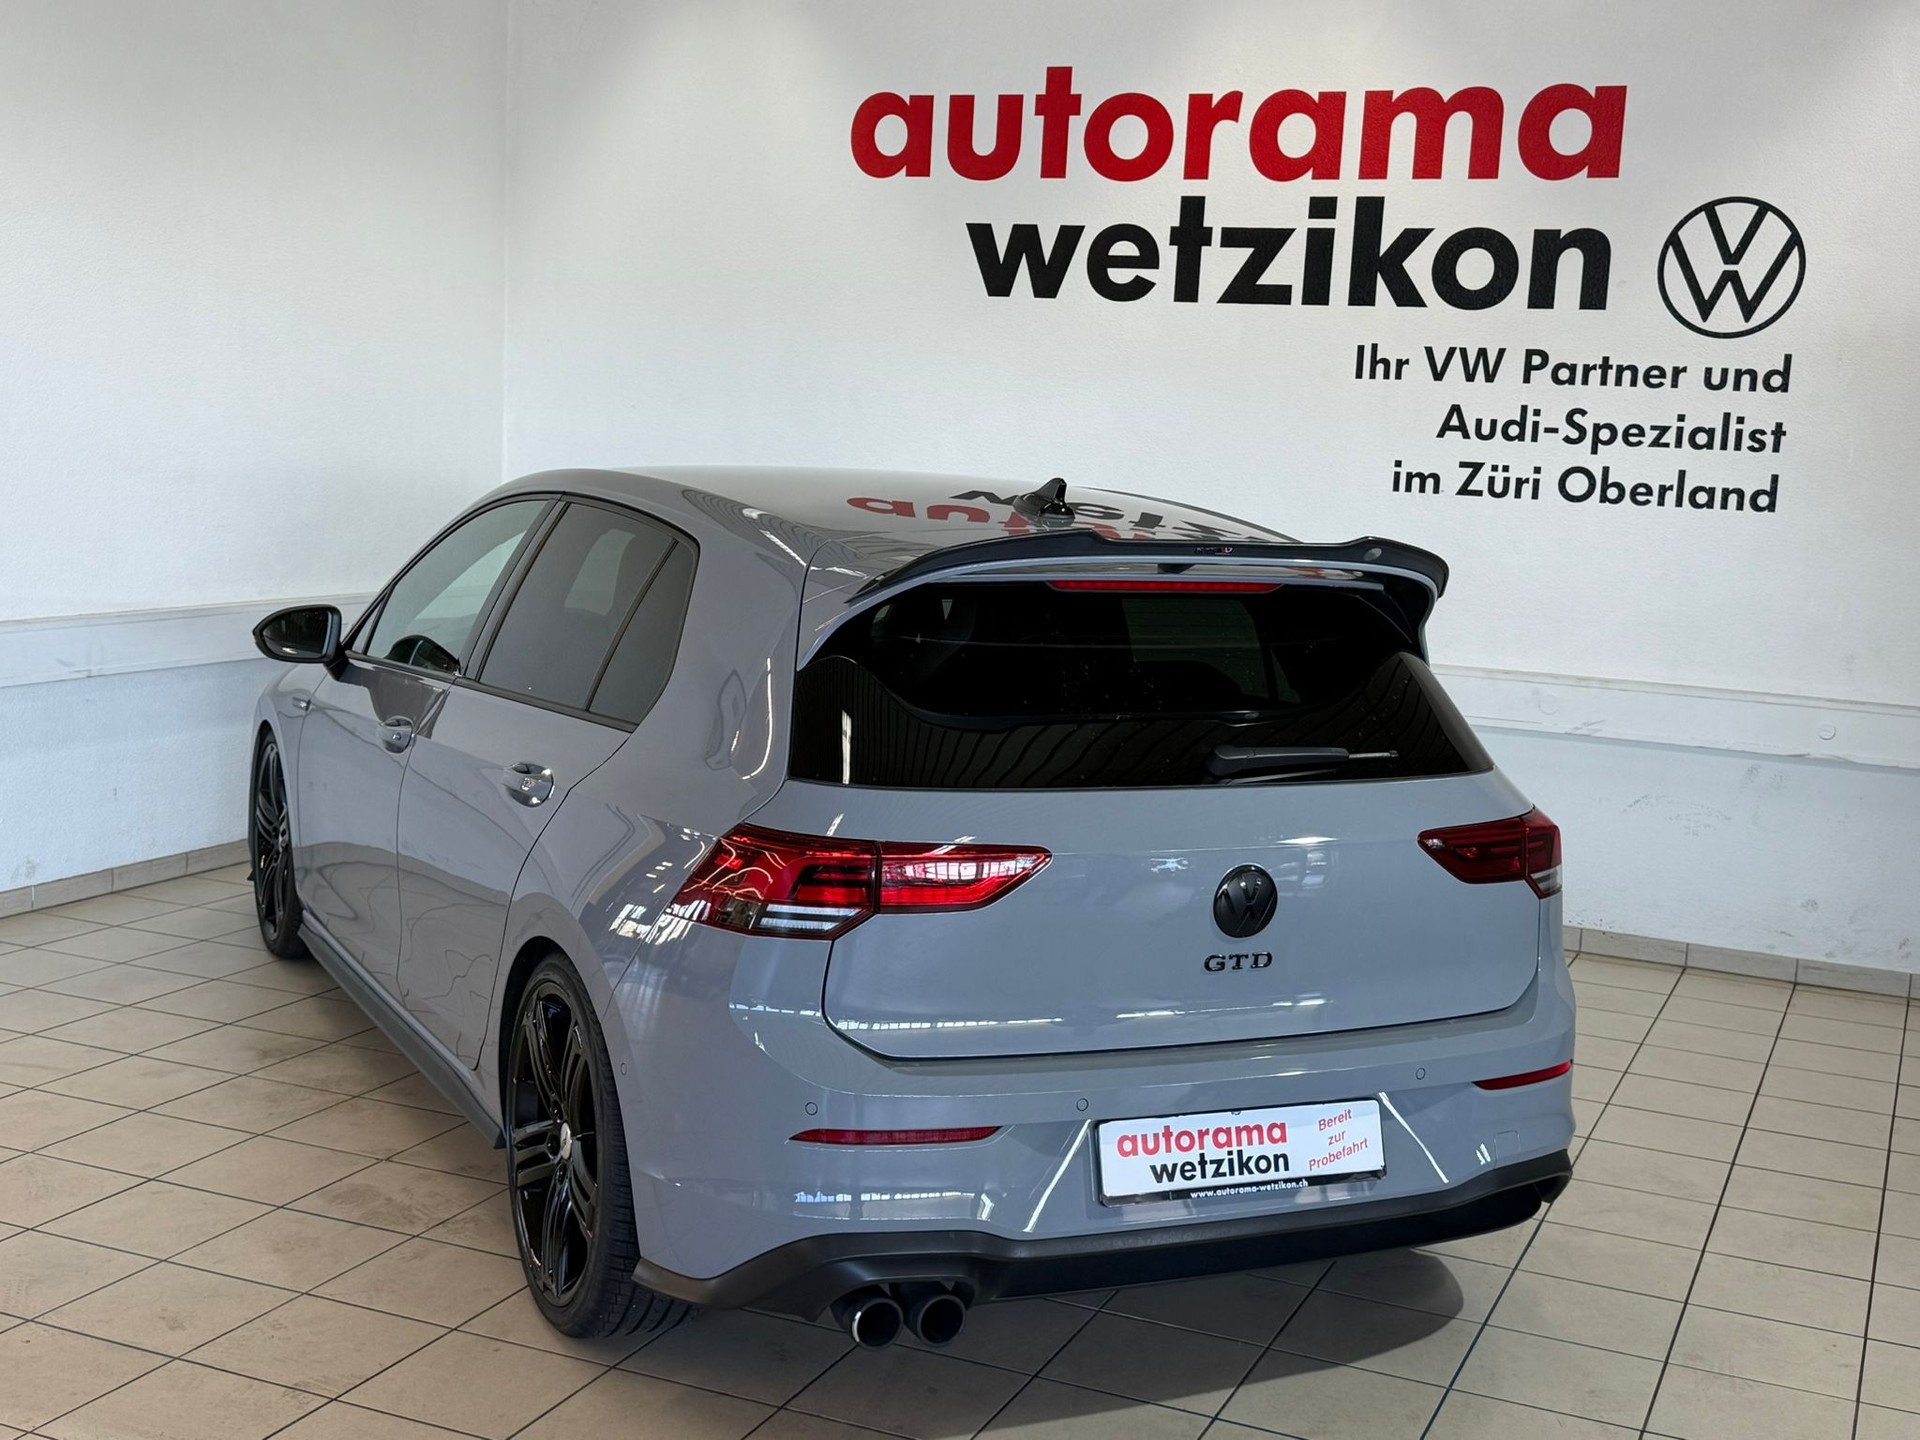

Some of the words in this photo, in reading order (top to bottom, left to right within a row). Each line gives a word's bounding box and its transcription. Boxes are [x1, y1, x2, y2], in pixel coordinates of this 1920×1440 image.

[851, 67, 1627, 182] autorama
[965, 195, 1612, 311] wetzikon
[1355, 342, 1410, 381] Ihr
[1423, 346, 1507, 384] VW
[1522, 348, 1688, 389] Partner
[1703, 353, 1793, 393] und
[1435, 403, 1787, 456] Audi-Spezialist
[1392, 459, 1441, 495] im
[1455, 461, 1542, 500] Züri
[1557, 465, 1780, 513] Oberland
[1204, 951, 1273, 972] GTD
[1318, 1109, 1352, 1132] Bereit
[1328, 1130, 1346, 1145] zur
[1116, 1121, 1288, 1158] autorama
[1308, 1137, 1369, 1171] Probefahrt
[1149, 1149, 1290, 1184] wetzikon
[1190, 1178, 1309, 1199] www.autorama-wetzikon.ch
